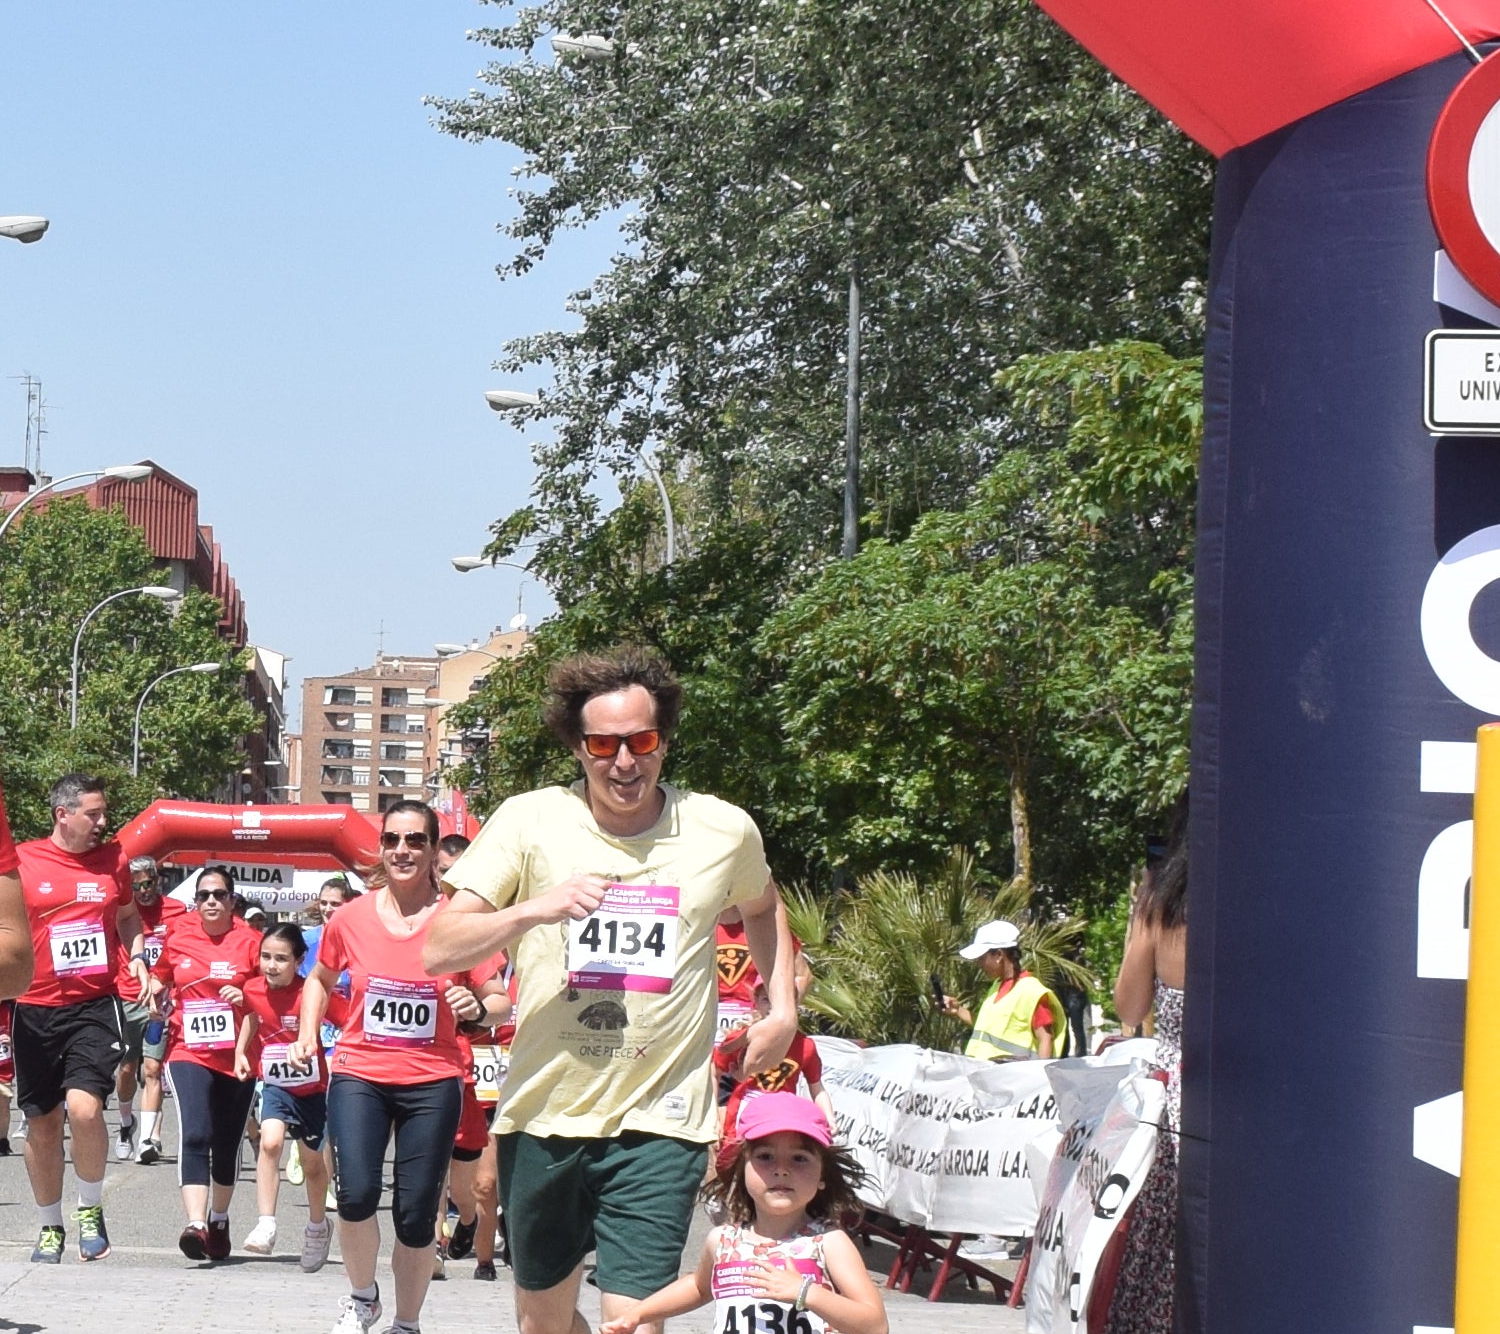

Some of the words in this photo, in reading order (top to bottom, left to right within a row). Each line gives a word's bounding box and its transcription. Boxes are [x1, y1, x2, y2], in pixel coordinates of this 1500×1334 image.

[217, 864, 283, 884] ALIDA
[579, 917, 666, 957] 4134
[61, 937, 98, 959] 4121
[370, 999, 430, 1026] 4100
[191, 1015, 227, 1033] 4119
[579, 1045, 601, 1056] ONE
[604, 1046, 633, 1059] PIECE
